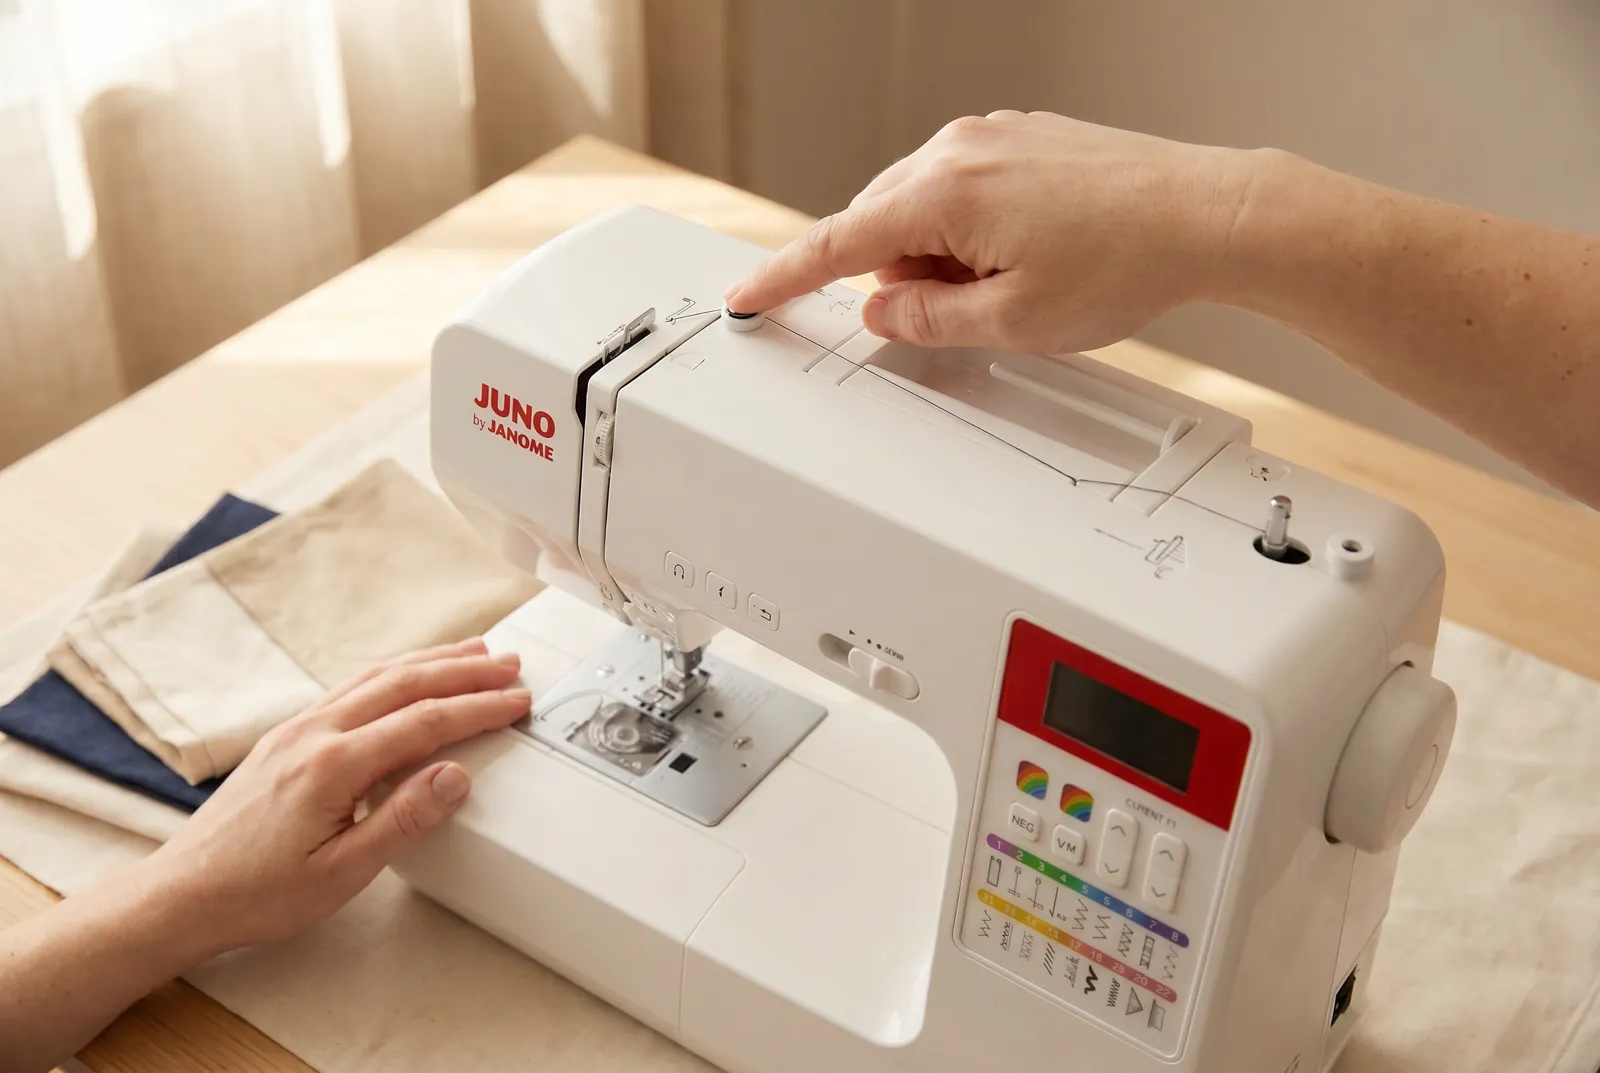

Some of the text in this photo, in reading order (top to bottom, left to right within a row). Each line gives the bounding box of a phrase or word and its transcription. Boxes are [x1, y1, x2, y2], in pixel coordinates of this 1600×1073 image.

[474, 383, 555, 438] JUNO
[473, 413, 554, 462] by JANOME
[1012, 814, 1034, 833] NEG
[1057, 837, 1077, 854] VM
[1016, 850, 1023, 861] 2
[1038, 861, 1044, 871] 3
[1060, 874, 1067, 883] 4
[1150, 920, 1157, 929] 7
[1133, 973, 1148, 985] 20
[1155, 985, 1171, 998] 22
